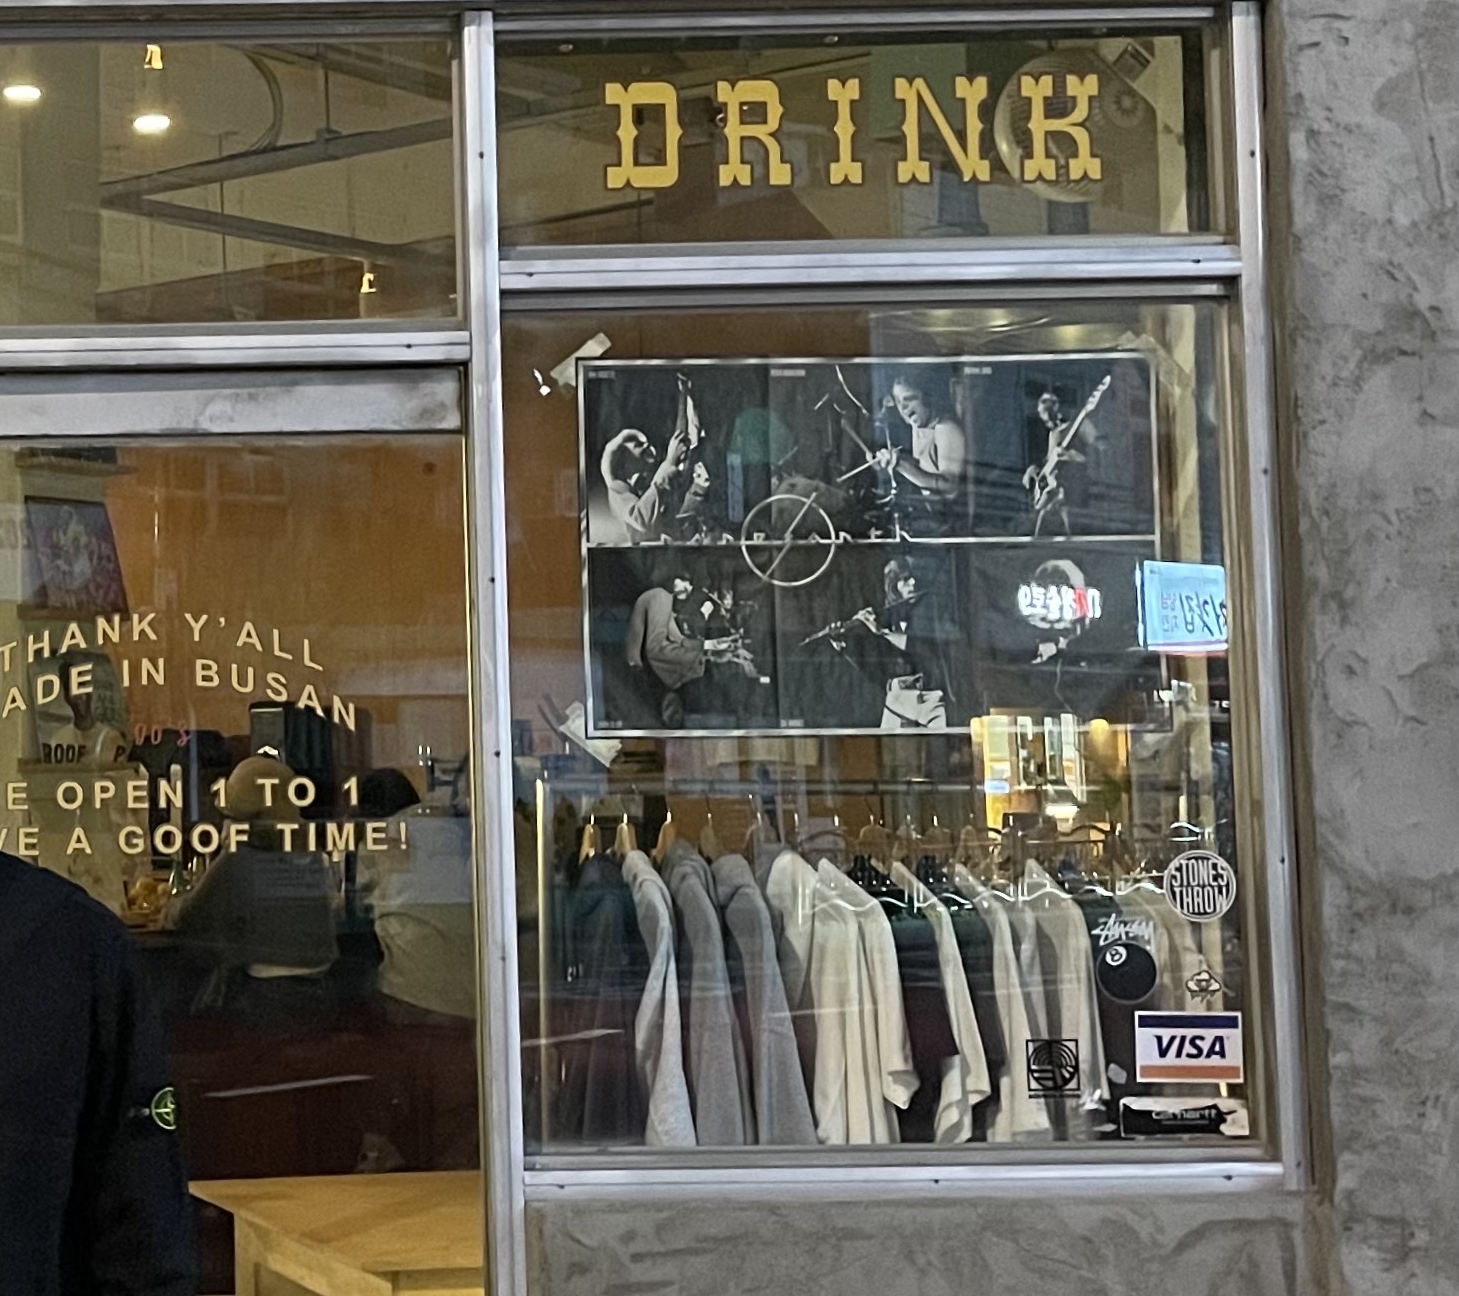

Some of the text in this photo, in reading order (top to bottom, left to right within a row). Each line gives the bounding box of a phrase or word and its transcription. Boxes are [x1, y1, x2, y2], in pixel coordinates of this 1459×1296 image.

[604, 74, 1103, 190] DRINK
[183, 612, 324, 673] Y'ALL
[121, 656, 166, 688] IN
[194, 658, 358, 733] BUSAN
[56, 778, 184, 811] OPEN
[210, 780, 228, 809] 1
[256, 776, 317, 808] TO
[342, 776, 360, 805] 1
[65, 826, 93, 856] A
[117, 822, 251, 856] GOOF
[276, 821, 409, 853] TIME!
[1171, 859, 1228, 887] STONES
[1173, 885, 1228, 915] THROW
[1153, 1034, 1228, 1060] VISA
